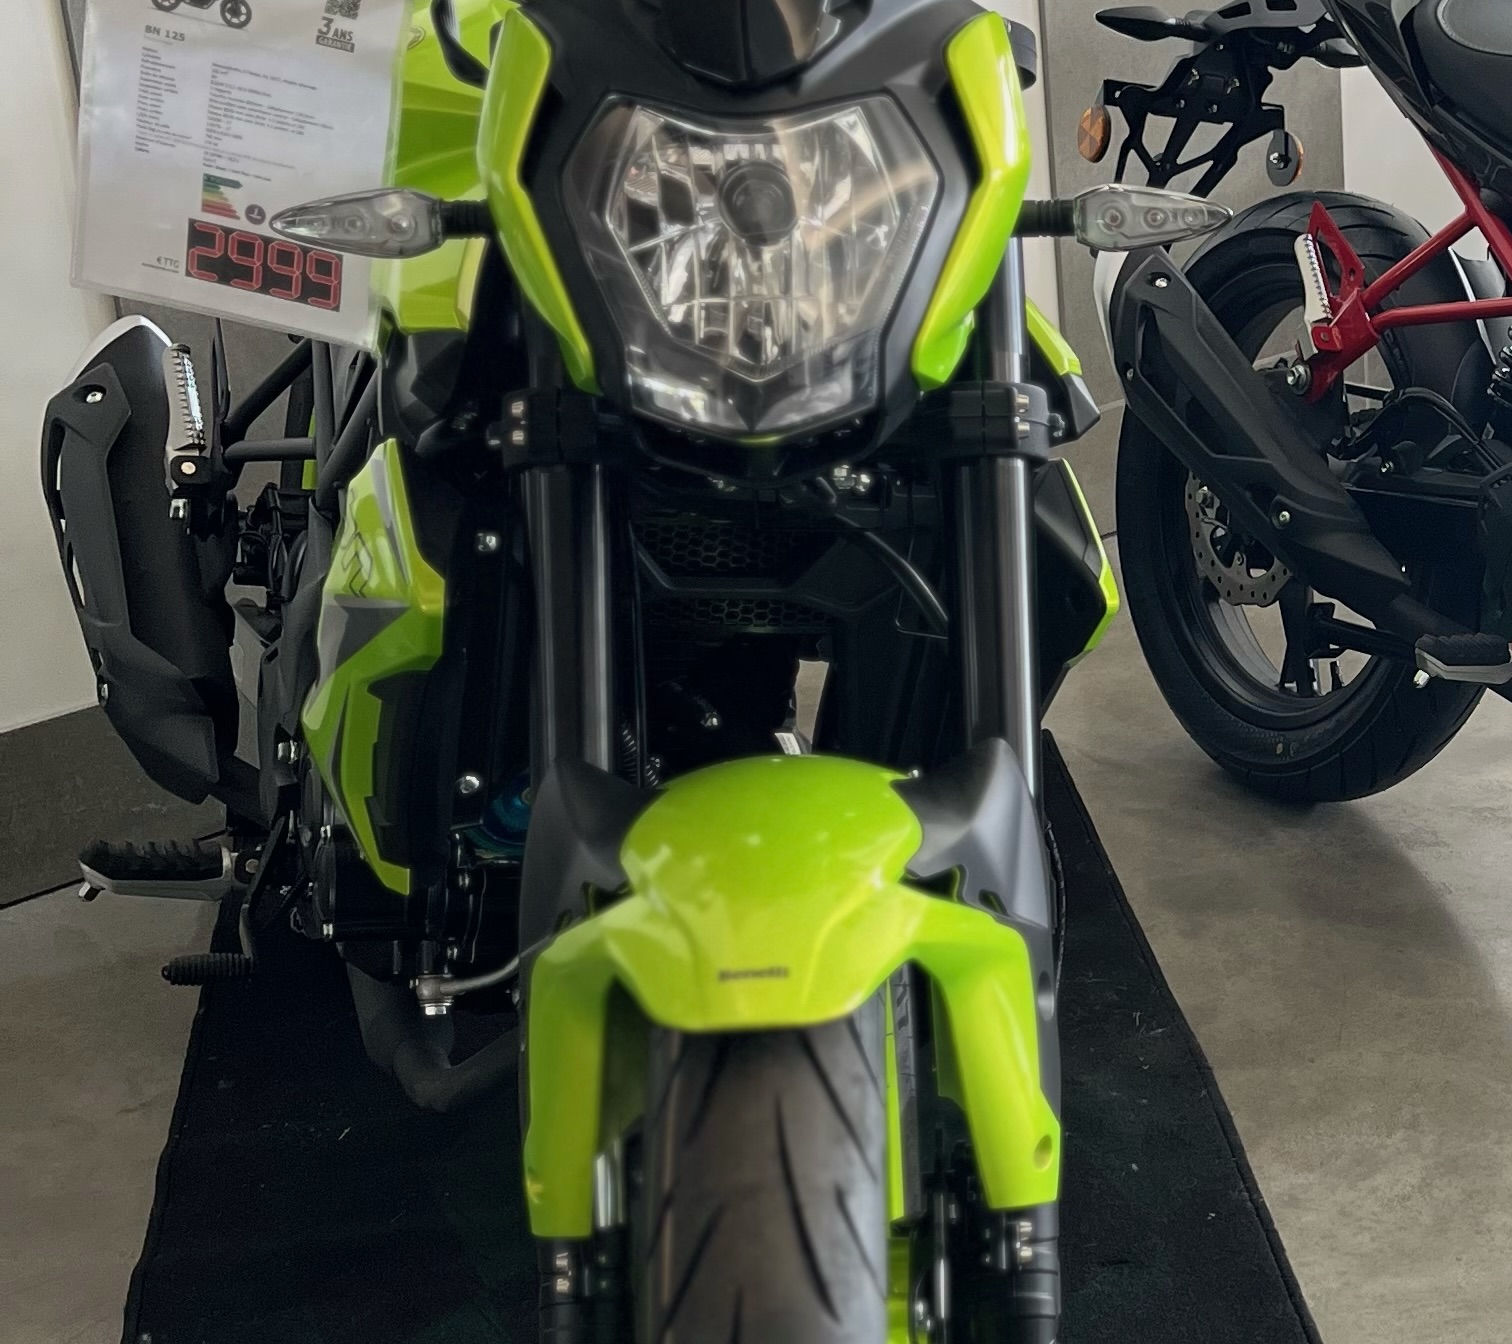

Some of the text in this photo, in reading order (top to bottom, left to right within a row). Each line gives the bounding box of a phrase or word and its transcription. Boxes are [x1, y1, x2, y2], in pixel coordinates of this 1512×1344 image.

[144, 25, 185, 42] BN 125
[332, 28, 354, 42] ANS
[188, 222, 341, 310] 2999
